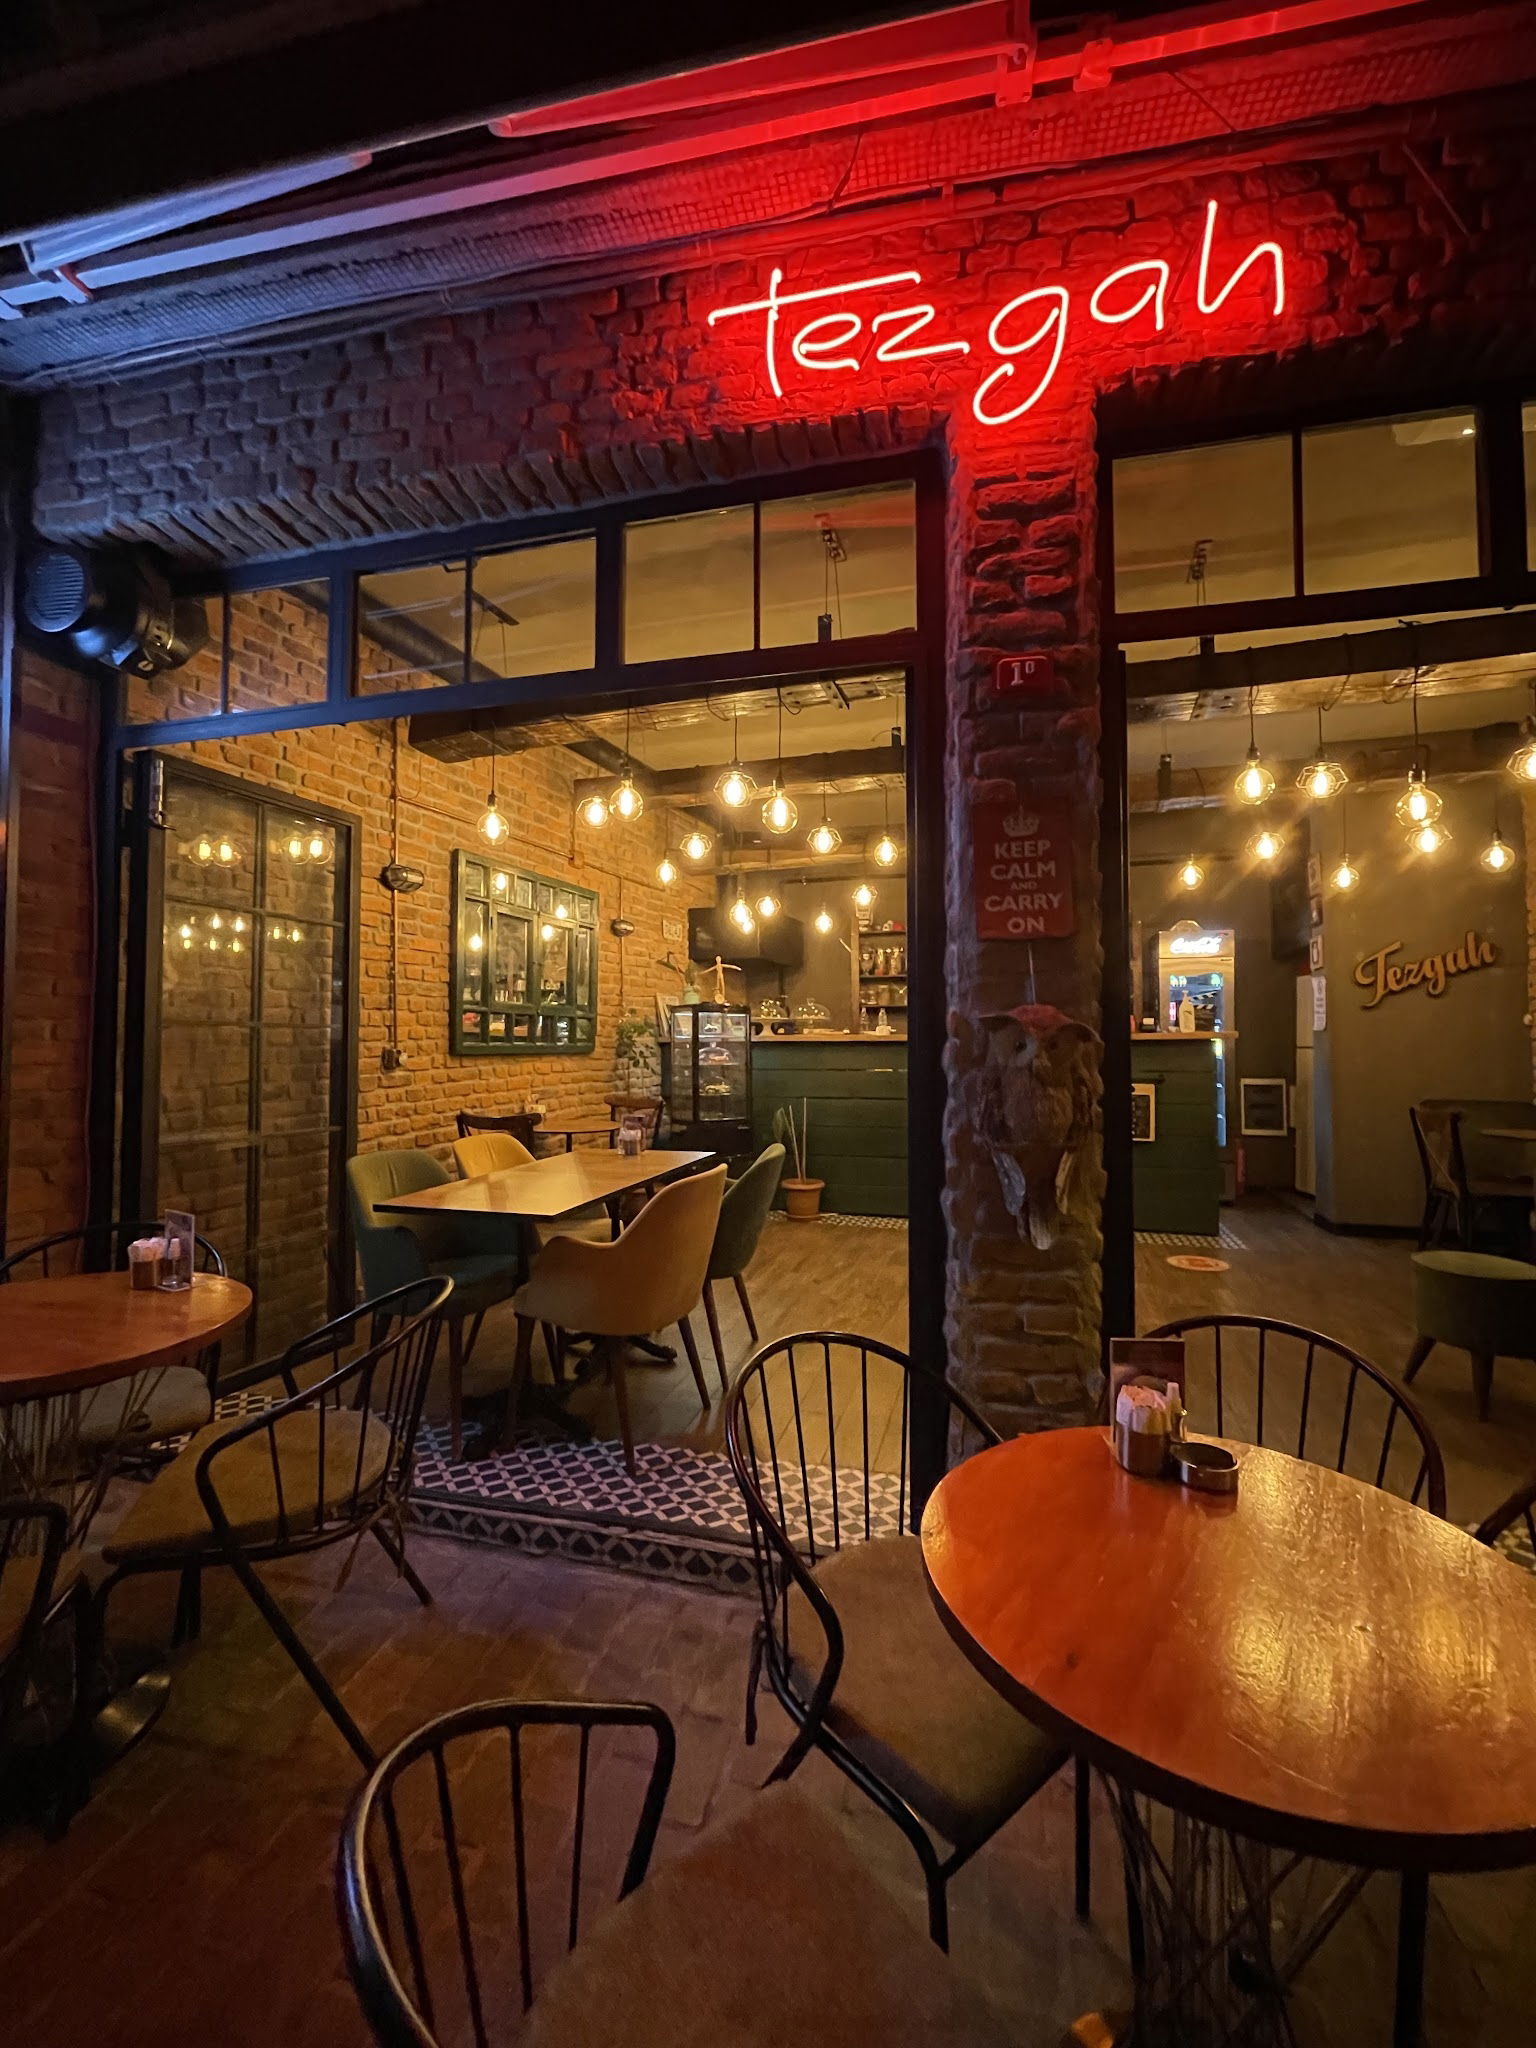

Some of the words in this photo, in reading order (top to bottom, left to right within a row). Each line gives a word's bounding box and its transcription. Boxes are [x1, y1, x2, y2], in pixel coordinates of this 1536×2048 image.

[994, 839, 1051, 859] KEEP
[990, 860, 1056, 881] CALM
[1010, 881, 1038, 891] AND
[984, 892, 1064, 912] CARRY
[1007, 916, 1045, 934] ON
[1354, 931, 1495, 1008] Tezgah
